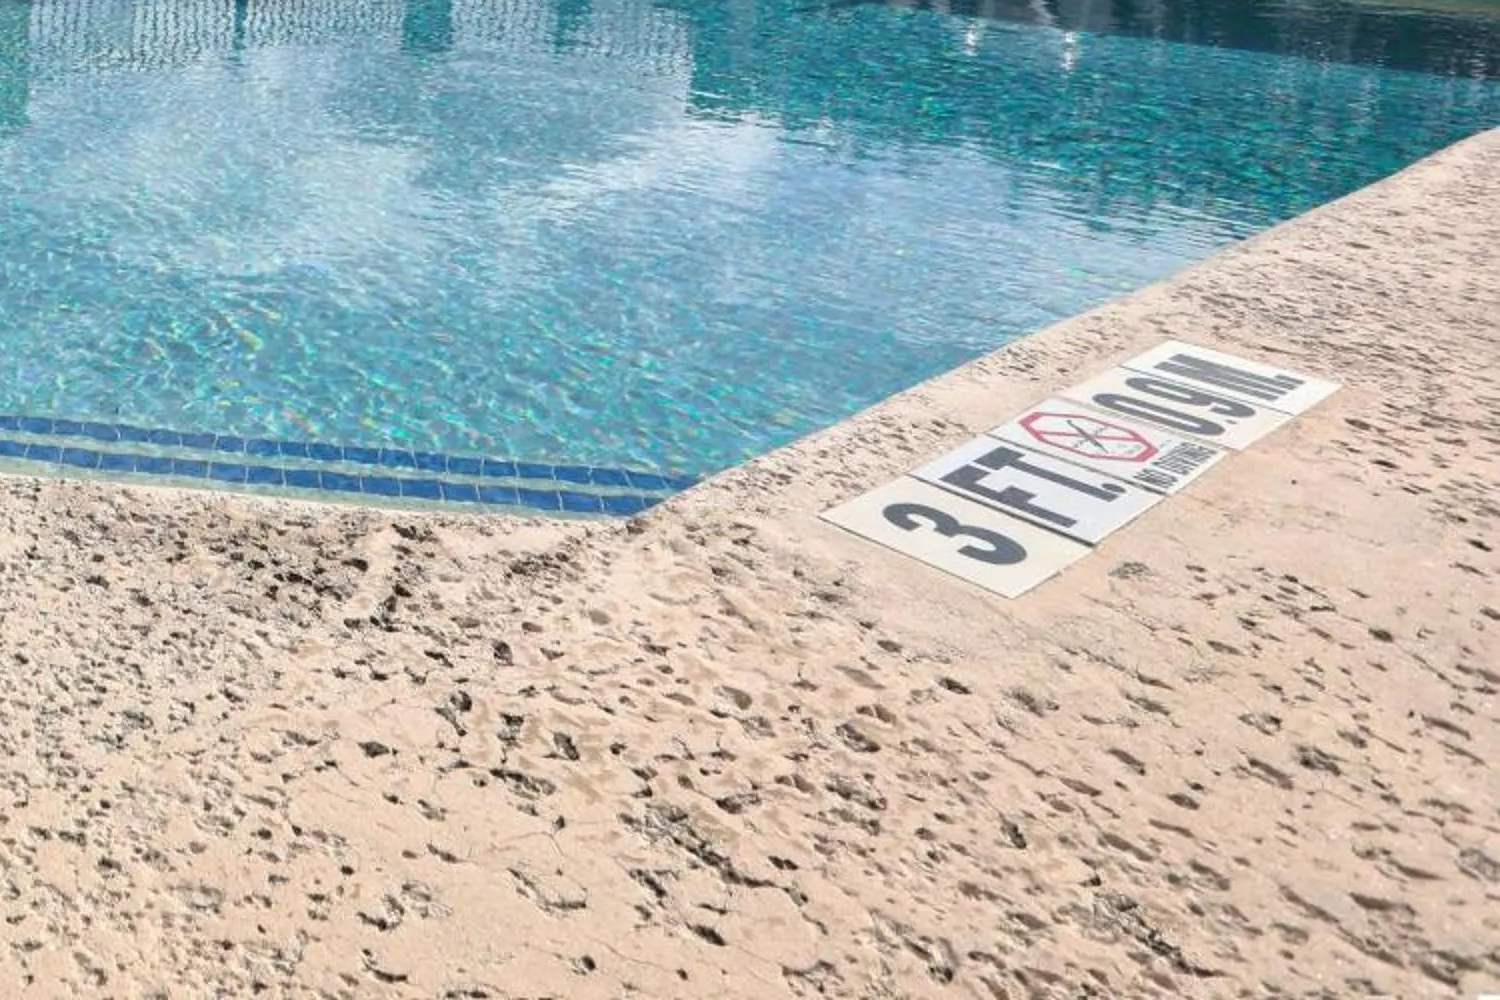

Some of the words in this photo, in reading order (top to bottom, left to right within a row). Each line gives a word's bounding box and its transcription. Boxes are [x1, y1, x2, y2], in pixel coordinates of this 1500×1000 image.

[1092, 376, 1256, 436] 0.9
[939, 446, 1127, 529] FT.
[1133, 468, 1179, 488] NO
[1150, 442, 1217, 475] DIVING
[882, 502, 1028, 565] 3
